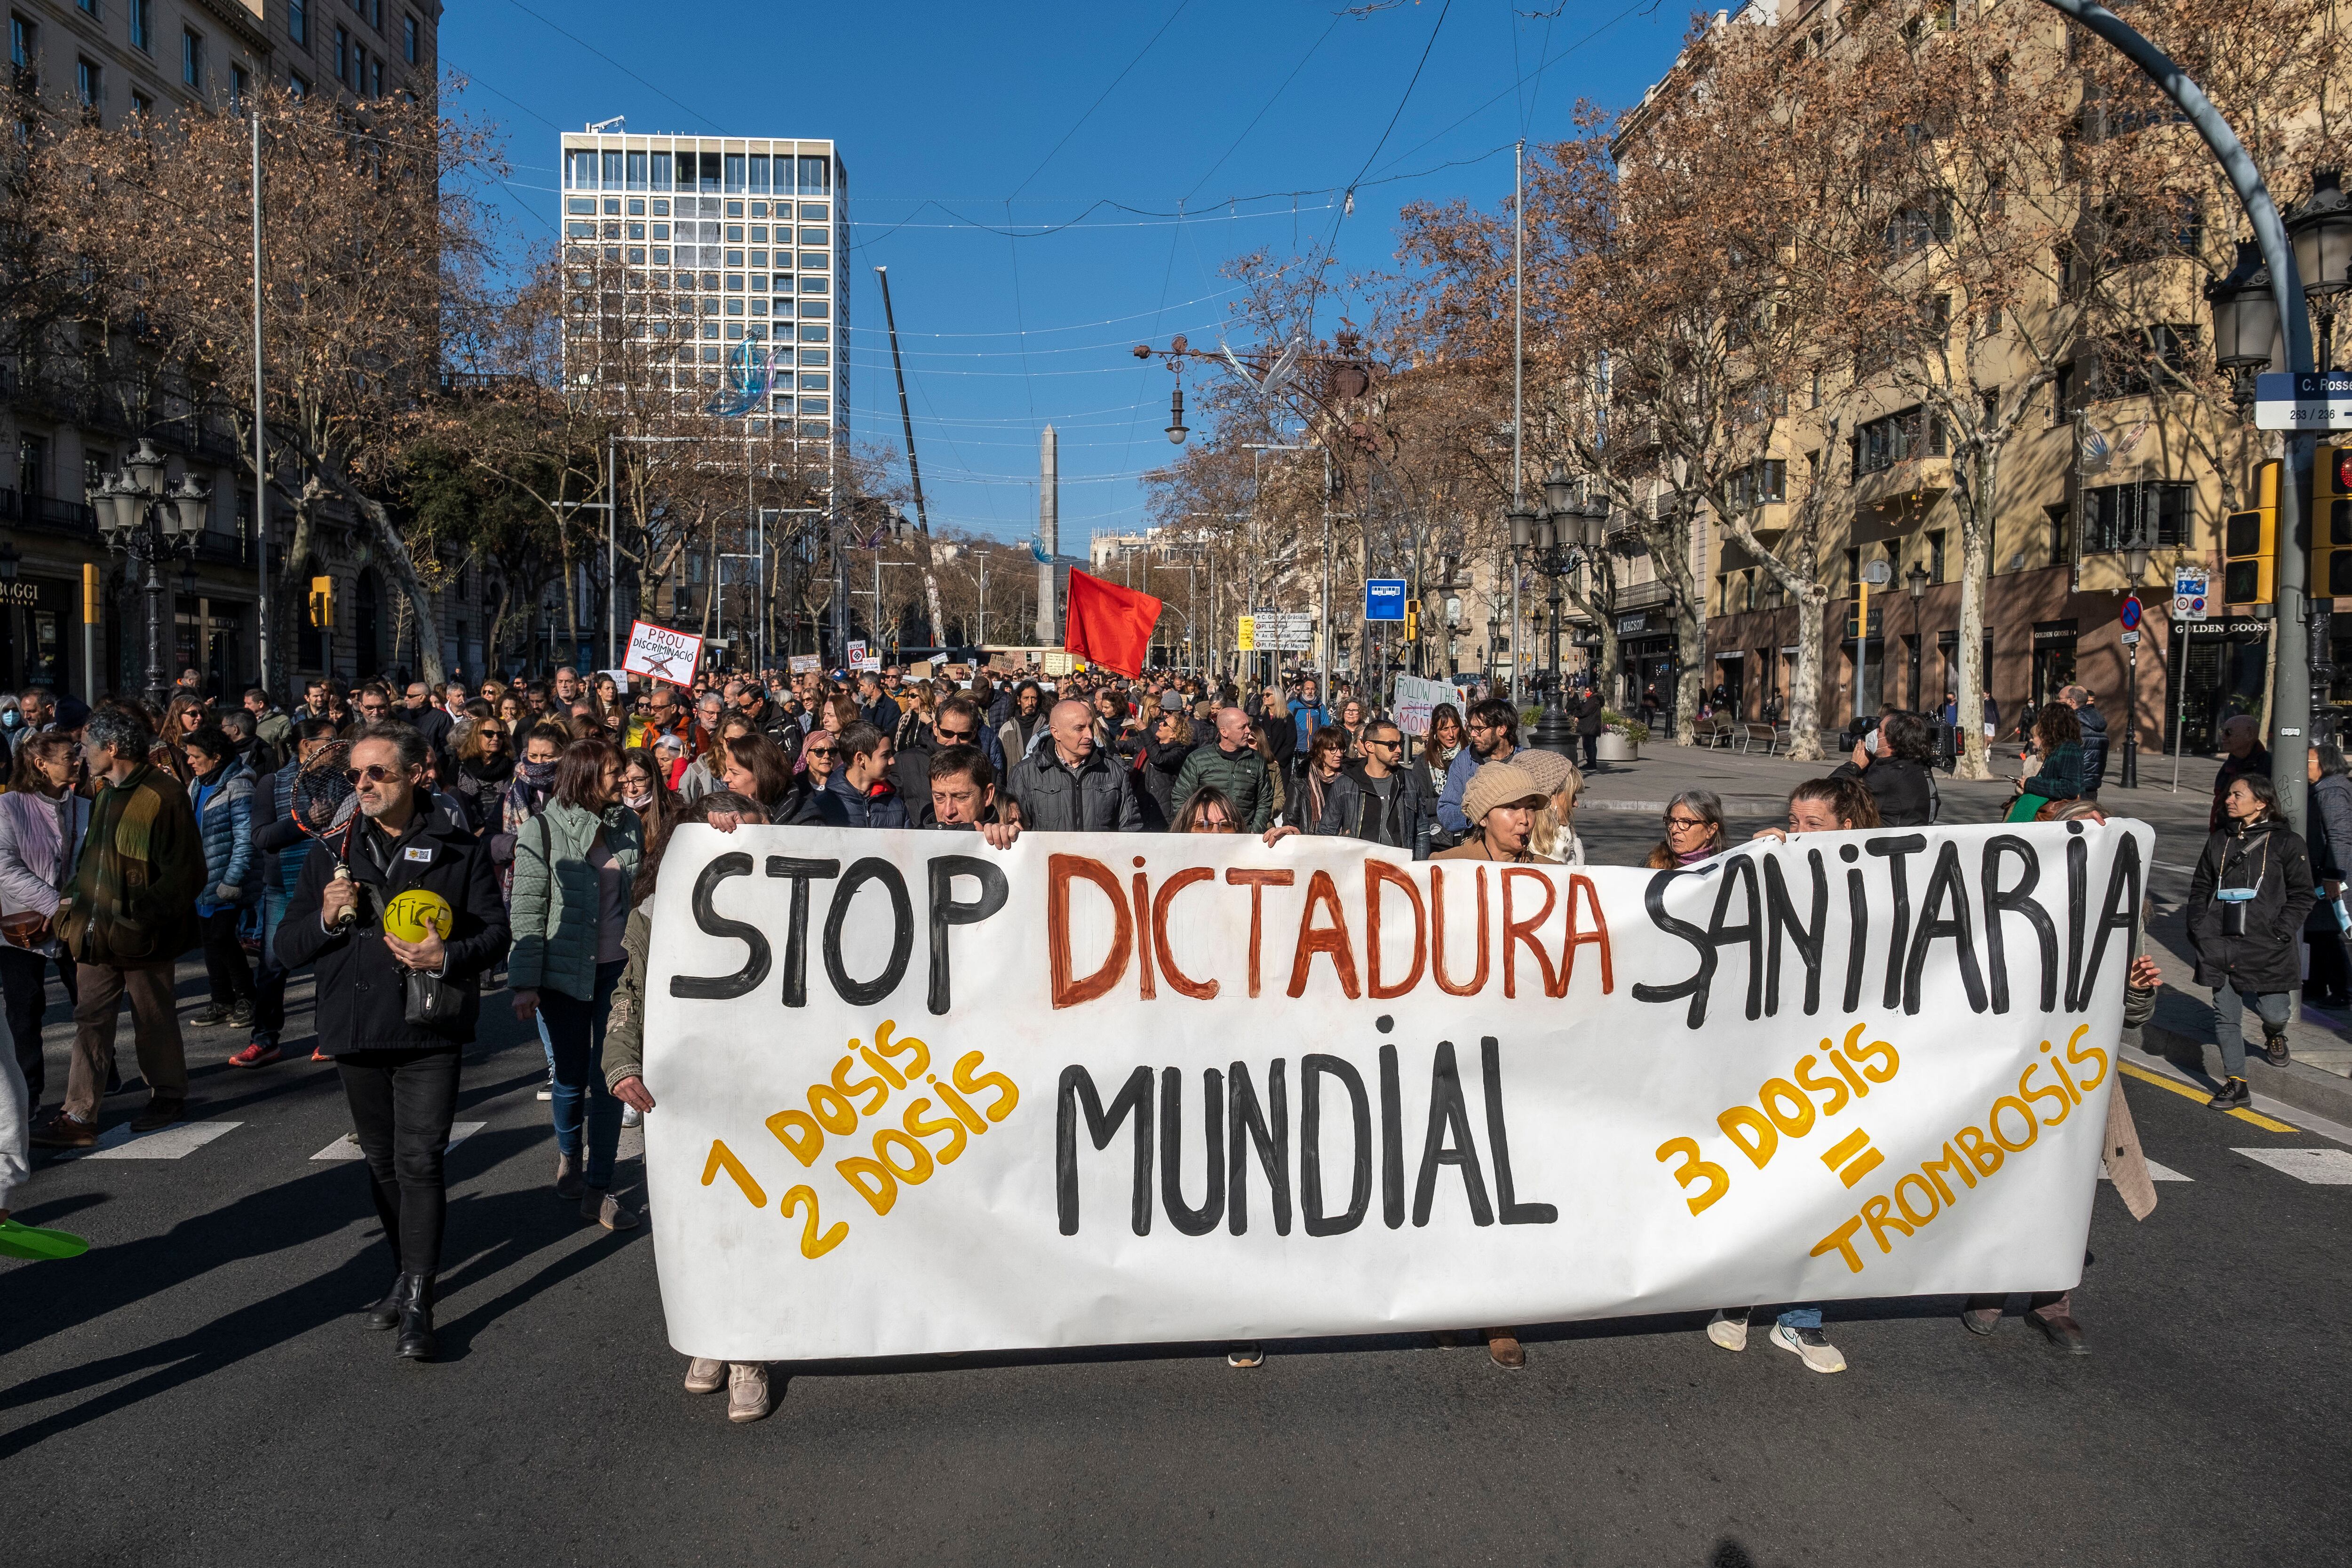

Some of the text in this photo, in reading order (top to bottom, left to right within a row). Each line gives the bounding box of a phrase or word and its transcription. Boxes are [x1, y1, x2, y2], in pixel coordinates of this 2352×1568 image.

[2302, 379, 2314, 391] C.
[2290, 410, 2307, 420] 263
[2318, 409, 2335, 419] 236
[1623, 619, 1645, 632] MACSON
[633, 638, 694, 662] DISCRIMINACIÓ
[648, 629, 684, 649] PROU
[1397, 677, 1456, 705] FOLLOW THE
[1406, 701, 1437, 717] SCIEN
[670, 852, 1009, 1015] STOP
[701, 1139, 767, 1208] 1
[1655, 1136, 1730, 1217] 3
[781, 1184, 850, 1259] 2
